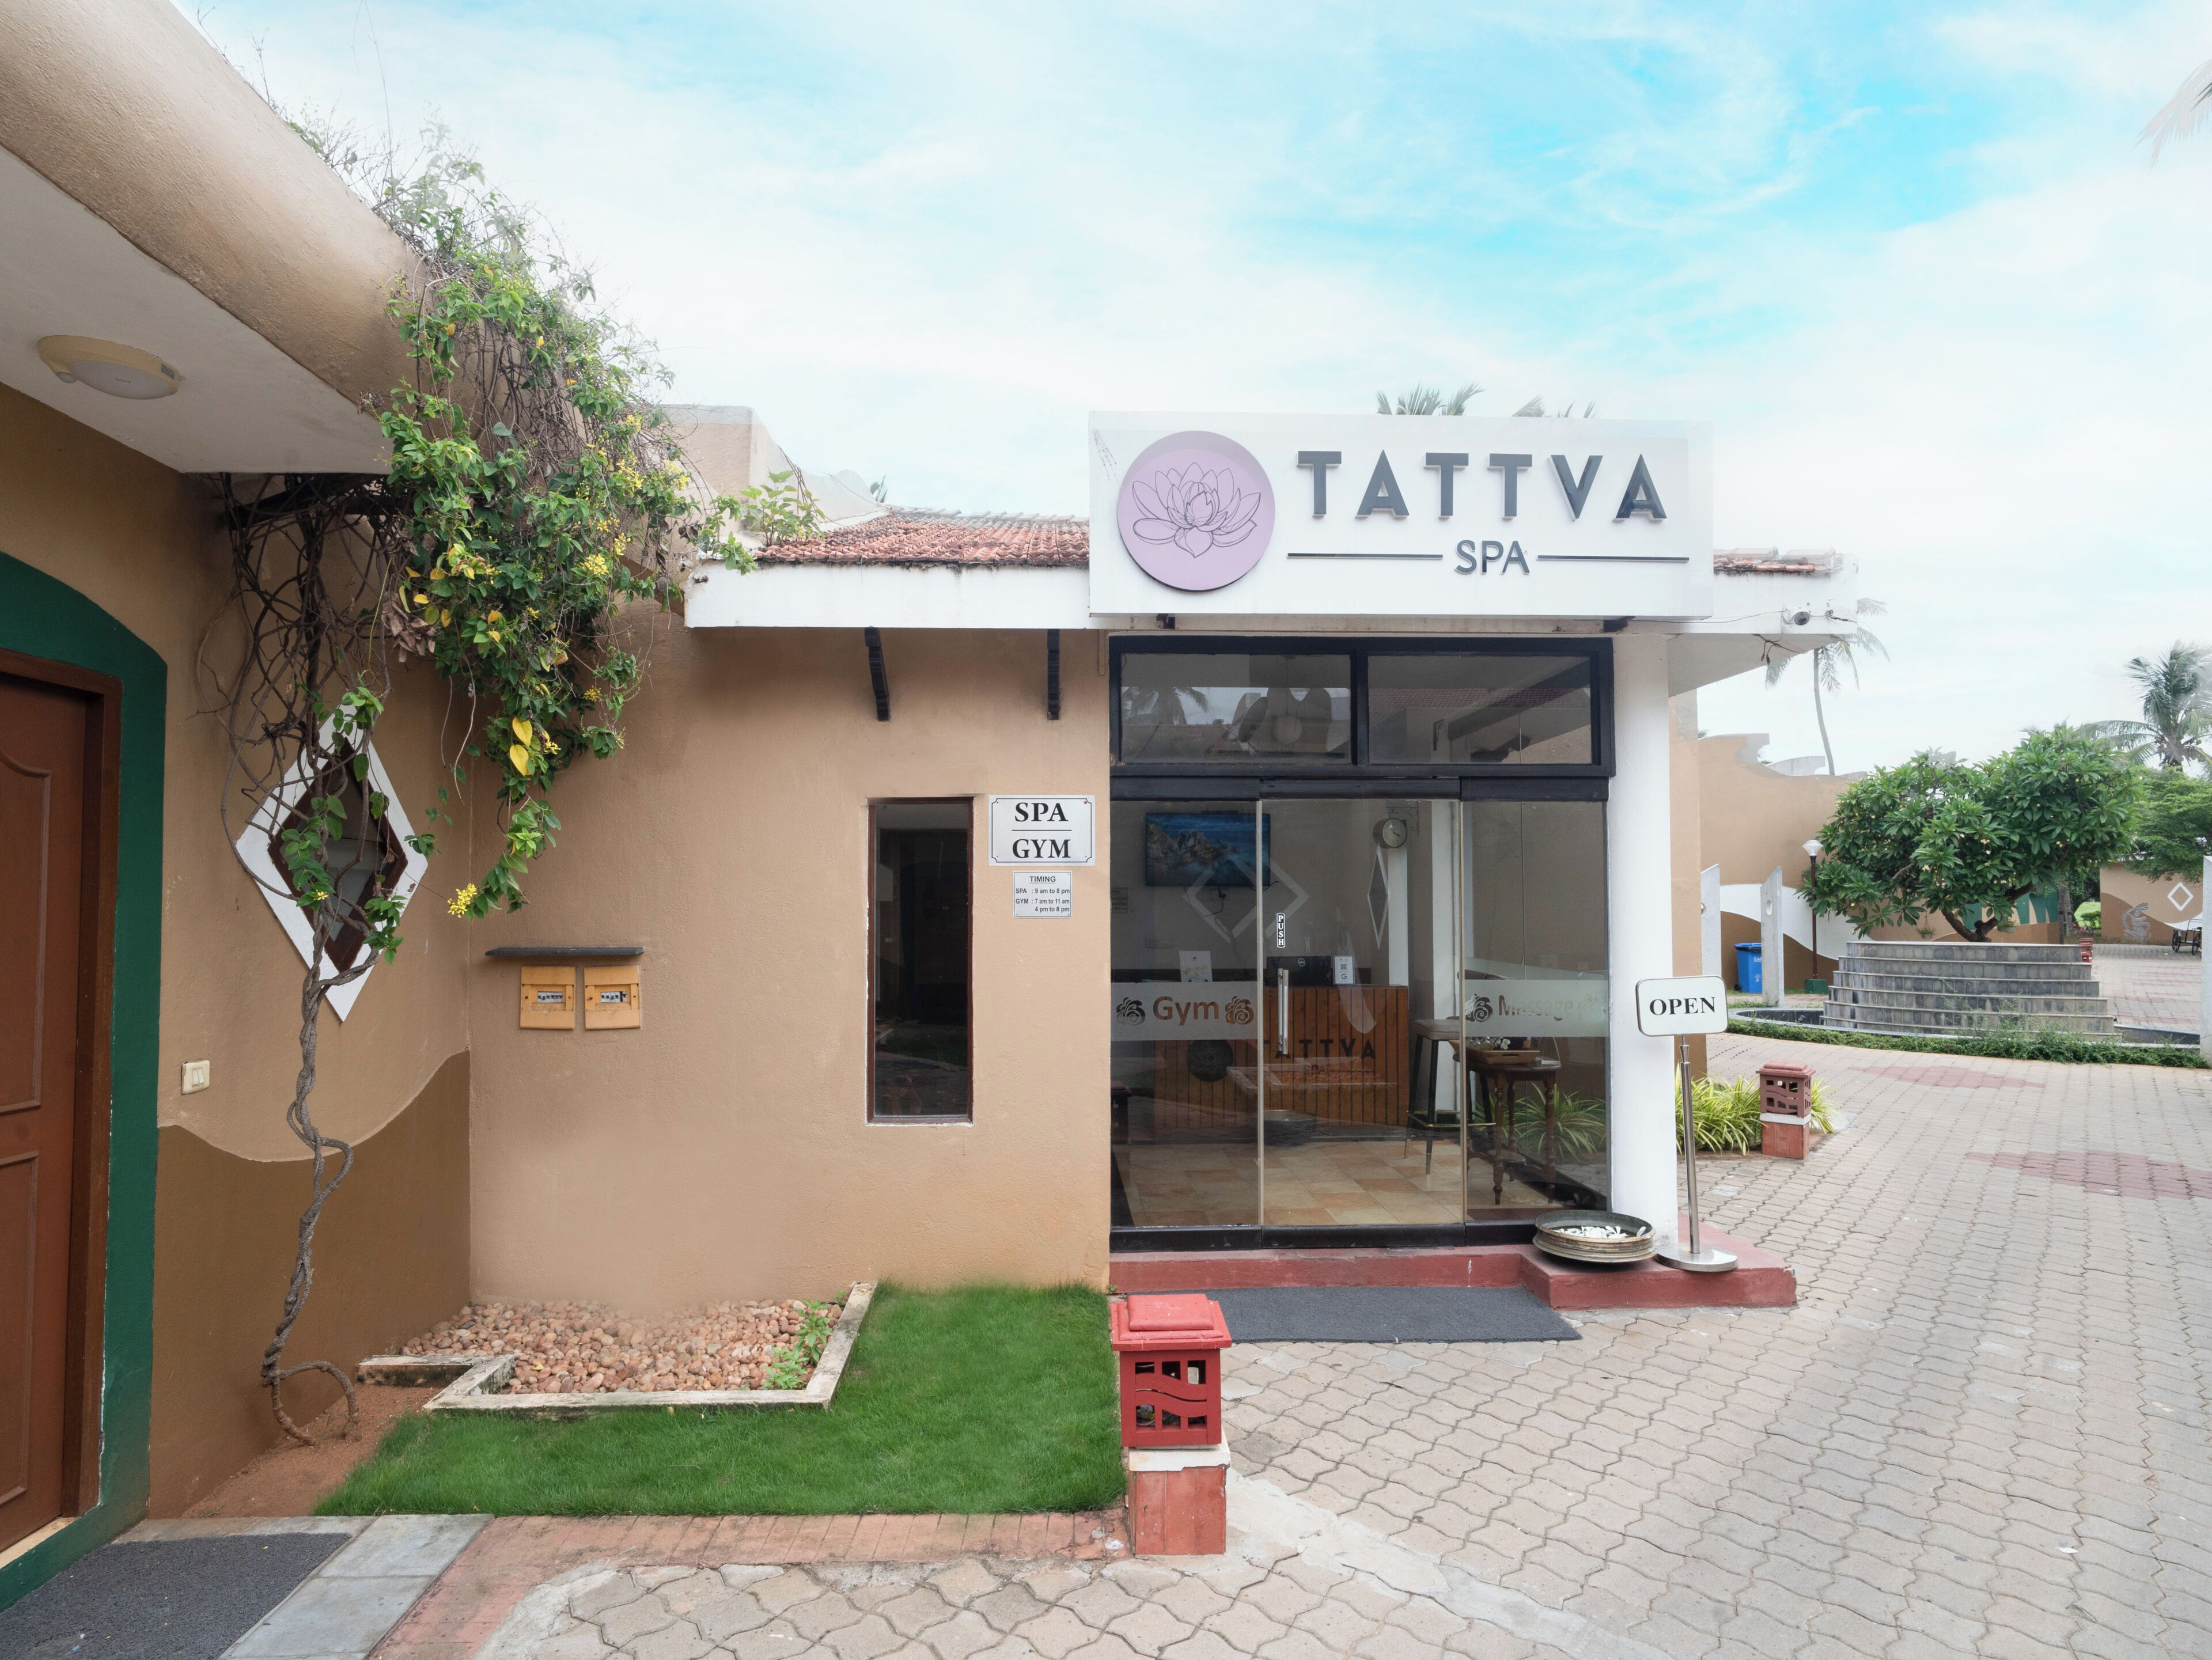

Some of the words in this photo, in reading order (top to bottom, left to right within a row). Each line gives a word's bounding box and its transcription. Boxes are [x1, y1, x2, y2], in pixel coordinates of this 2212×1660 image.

[1296, 449, 1668, 521] TATTVA
[1454, 539, 1531, 575] SPA
[1014, 802, 1069, 822] SPA
[1012, 839, 1071, 859] GYM
[1153, 996, 1219, 1026] Gym
[1649, 996, 1717, 1016] OPEN
